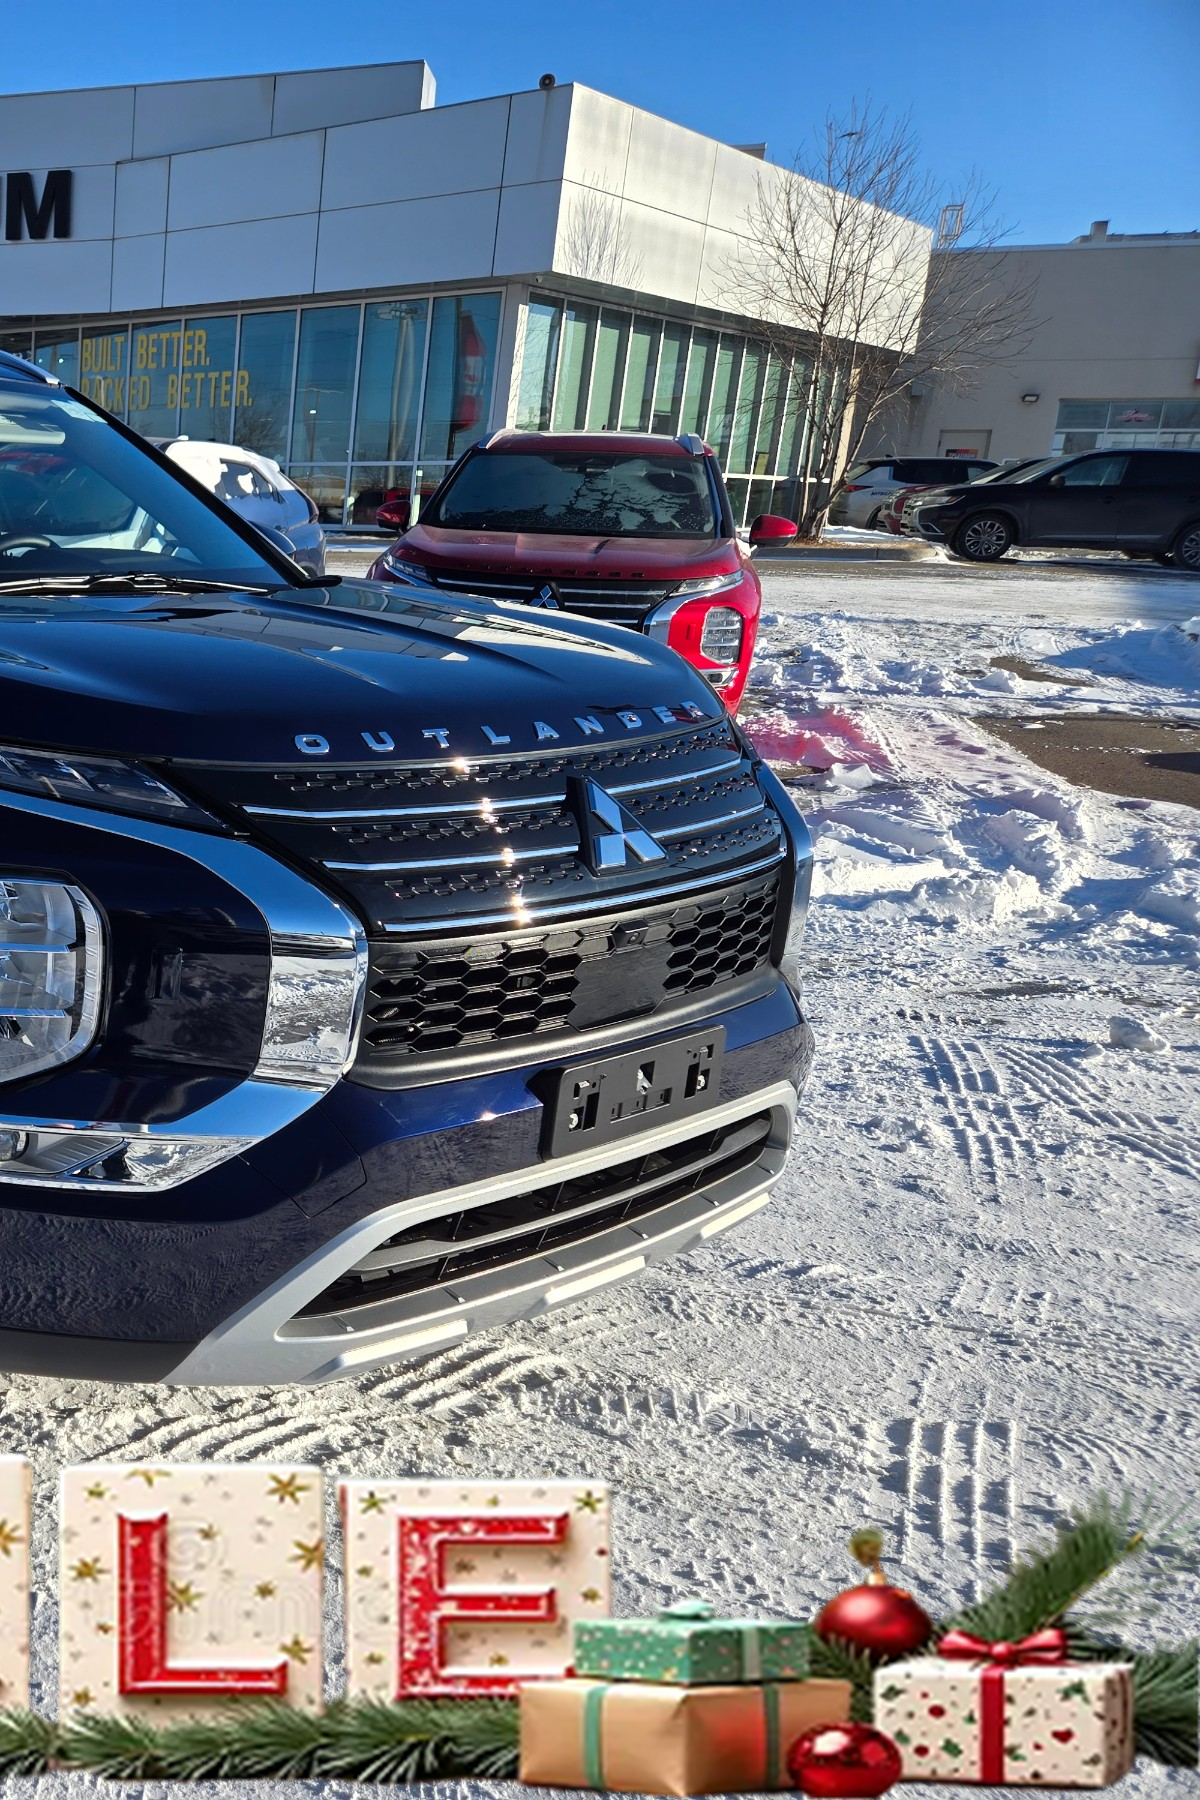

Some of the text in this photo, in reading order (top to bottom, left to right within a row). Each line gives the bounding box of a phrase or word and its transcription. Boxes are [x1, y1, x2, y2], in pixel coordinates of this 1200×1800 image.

[82, 329, 211, 373] BUILT BETTER.
[166, 370, 253, 410] BETTER.
[294, 700, 703, 755] OUTLANDER
